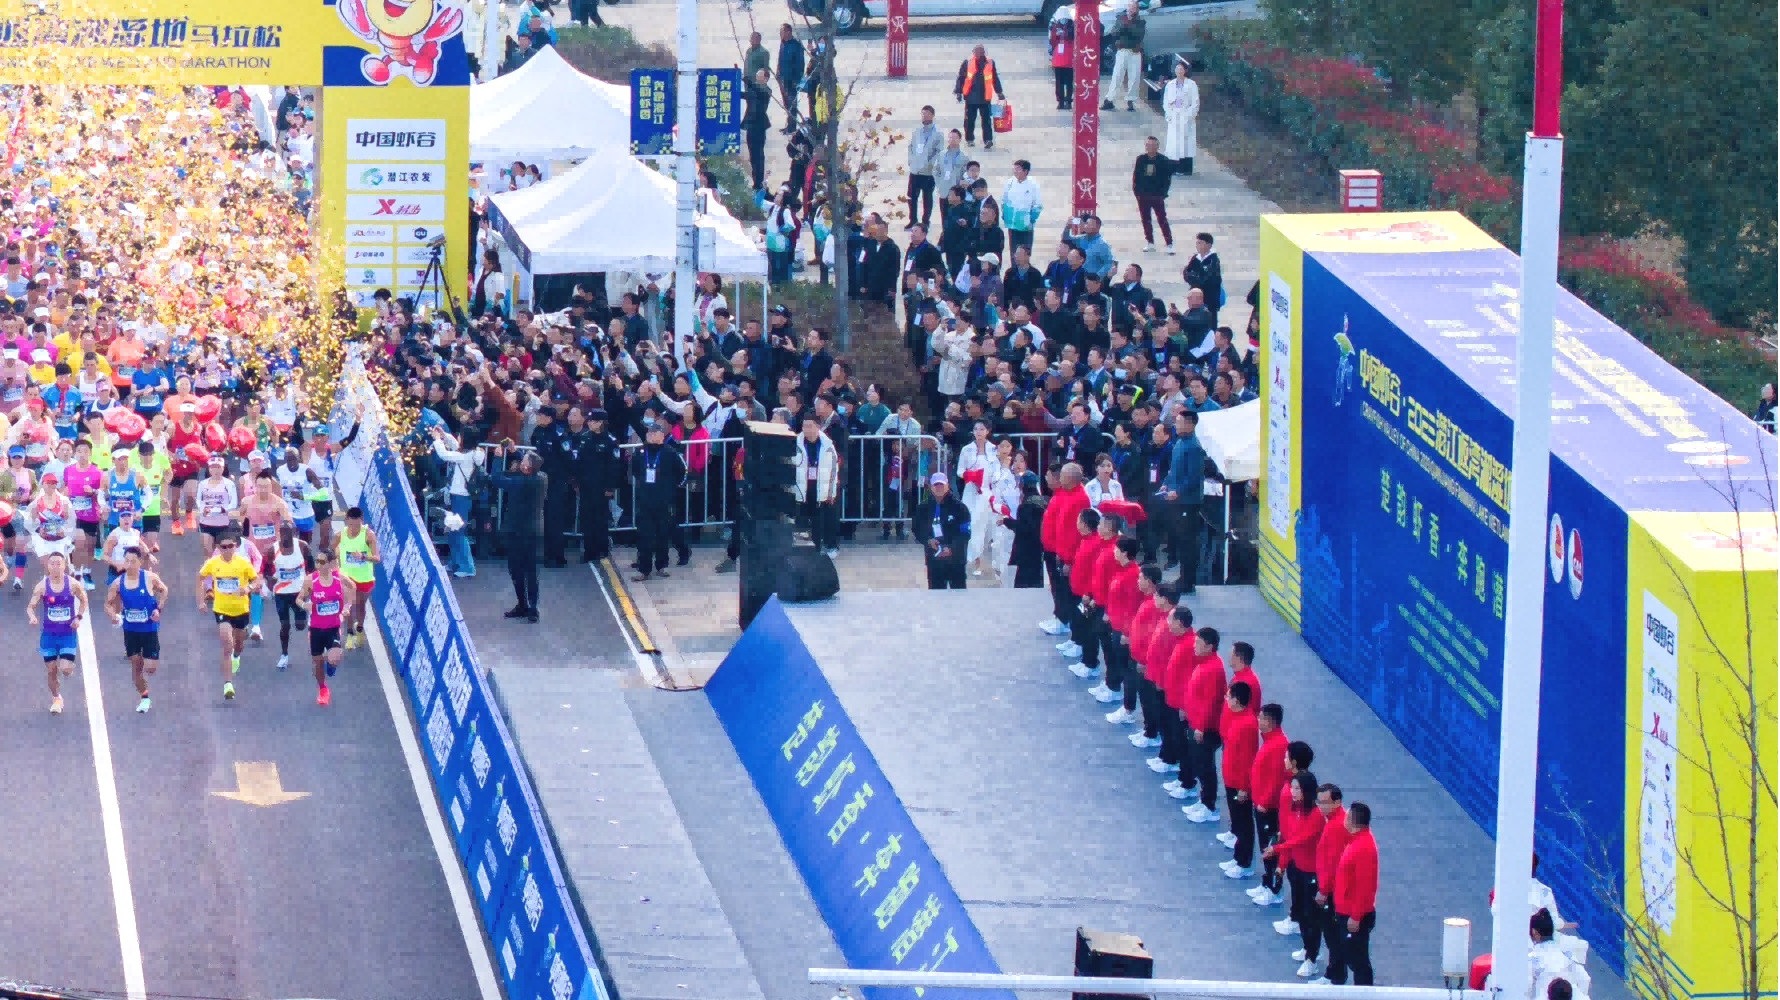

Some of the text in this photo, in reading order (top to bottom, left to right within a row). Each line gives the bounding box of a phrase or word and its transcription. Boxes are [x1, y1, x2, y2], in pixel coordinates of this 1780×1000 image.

[356, 131, 436, 148] 中国虾谷
[387, 172, 432, 183] 潜江农发
